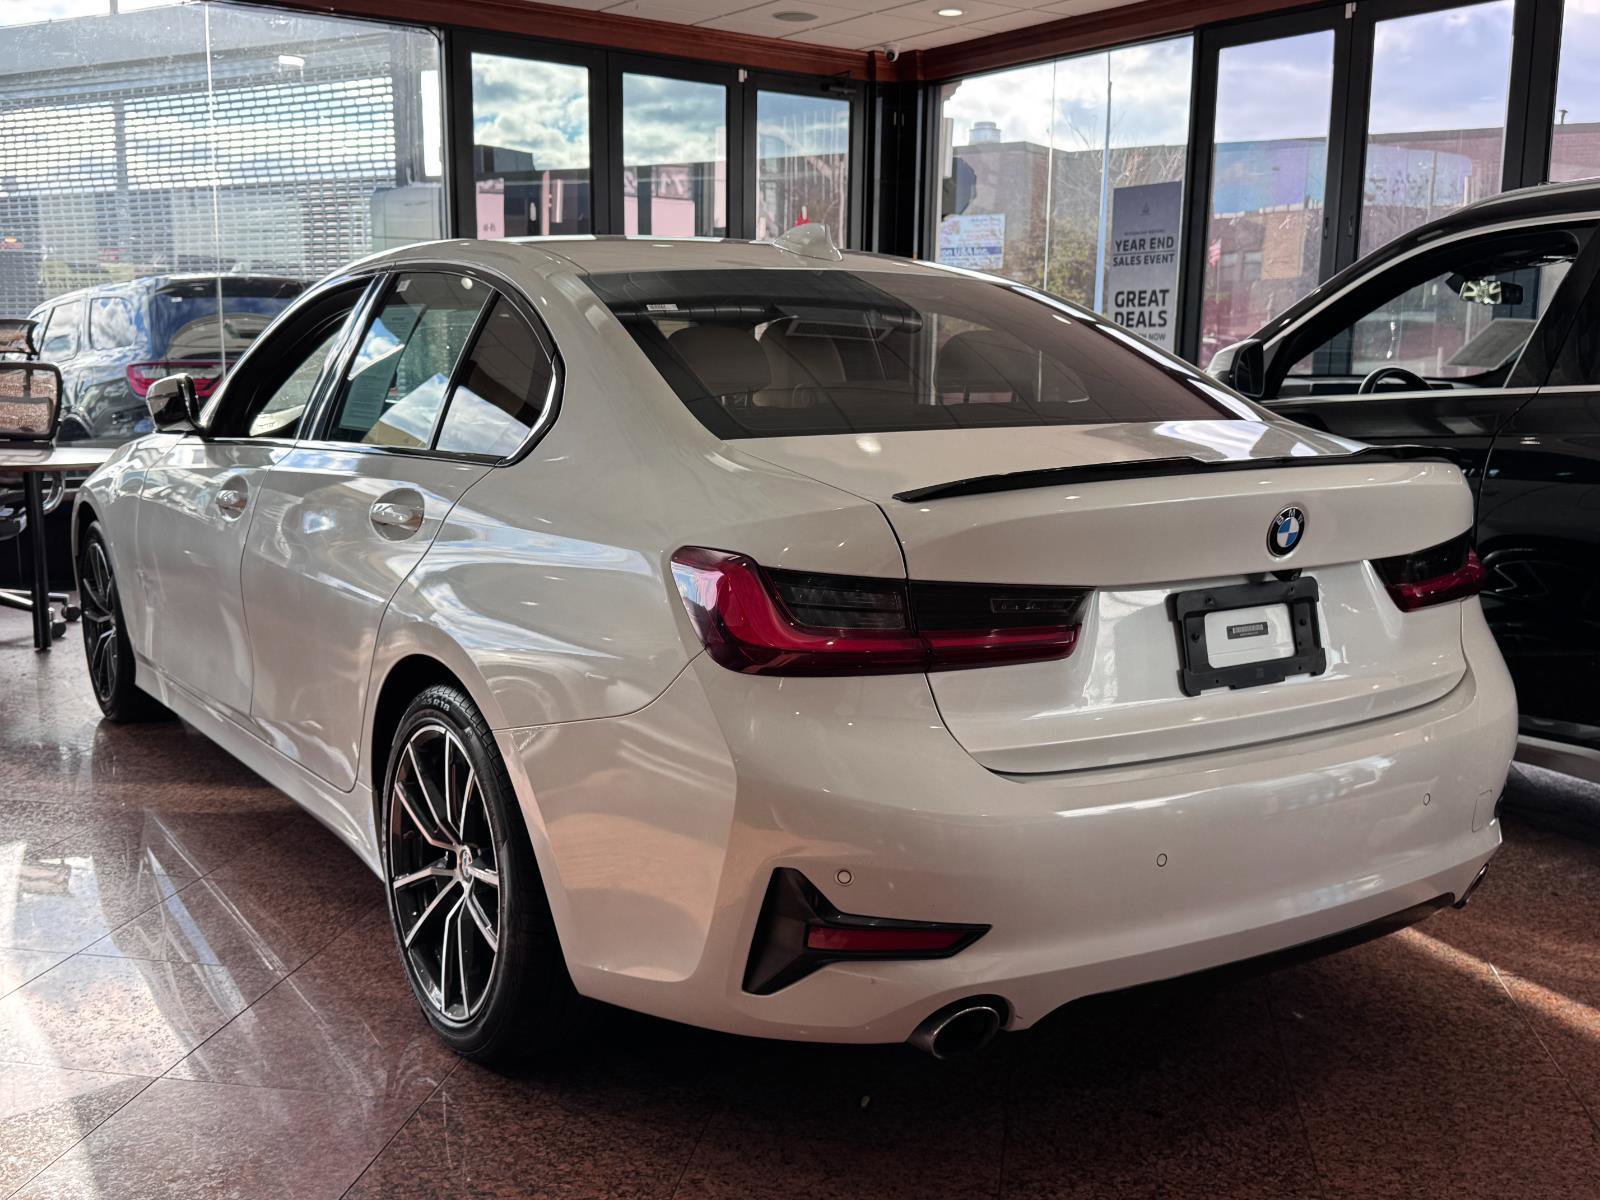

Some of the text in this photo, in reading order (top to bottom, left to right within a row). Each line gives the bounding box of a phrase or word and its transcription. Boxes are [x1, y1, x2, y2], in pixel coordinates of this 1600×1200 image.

[1115, 236, 1174, 252] YEAR END
[1113, 253, 1175, 266] SALES EVENT
[1115, 289, 1170, 308] GREAT
[1115, 310, 1167, 328] DEALS
[1148, 333, 1166, 341] NOW
[1276, 508, 1304, 525] BMW
